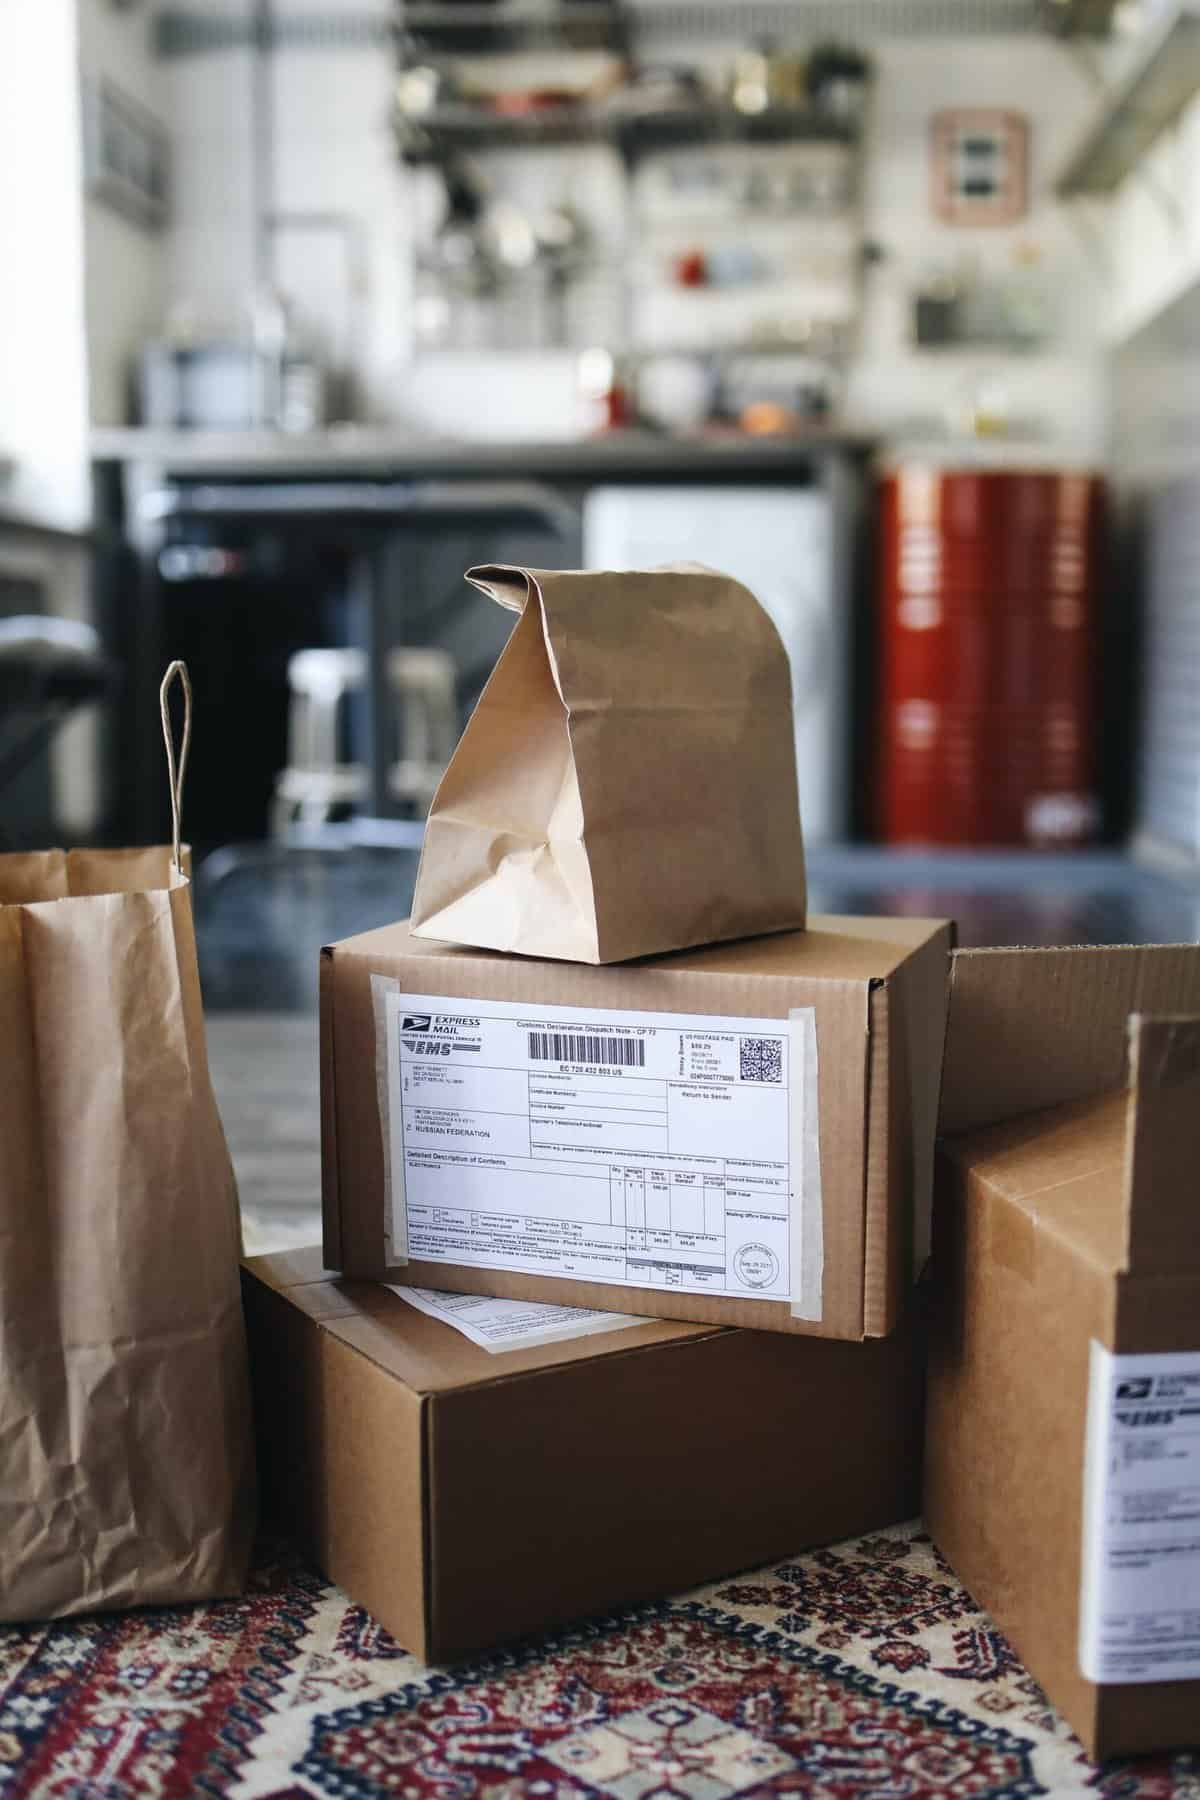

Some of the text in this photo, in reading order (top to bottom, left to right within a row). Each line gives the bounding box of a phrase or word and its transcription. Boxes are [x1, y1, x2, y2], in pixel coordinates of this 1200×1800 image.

[436, 1016, 480, 1026] EXPRESS
[432, 1026, 458, 1034] MAIL
[516, 1021, 545, 1030] Customs
[547, 1023, 583, 1032] Declaration
[584, 1025, 613, 1035] Dispatch
[415, 1040, 451, 1056] EMS
[415, 1125, 445, 1135] RUSSIAN
[446, 1128, 490, 1138] FEDERATION
[407, 1150, 432, 1158] Detailed
[433, 1152, 468, 1162] Description
[479, 1157, 506, 1166] Contents
